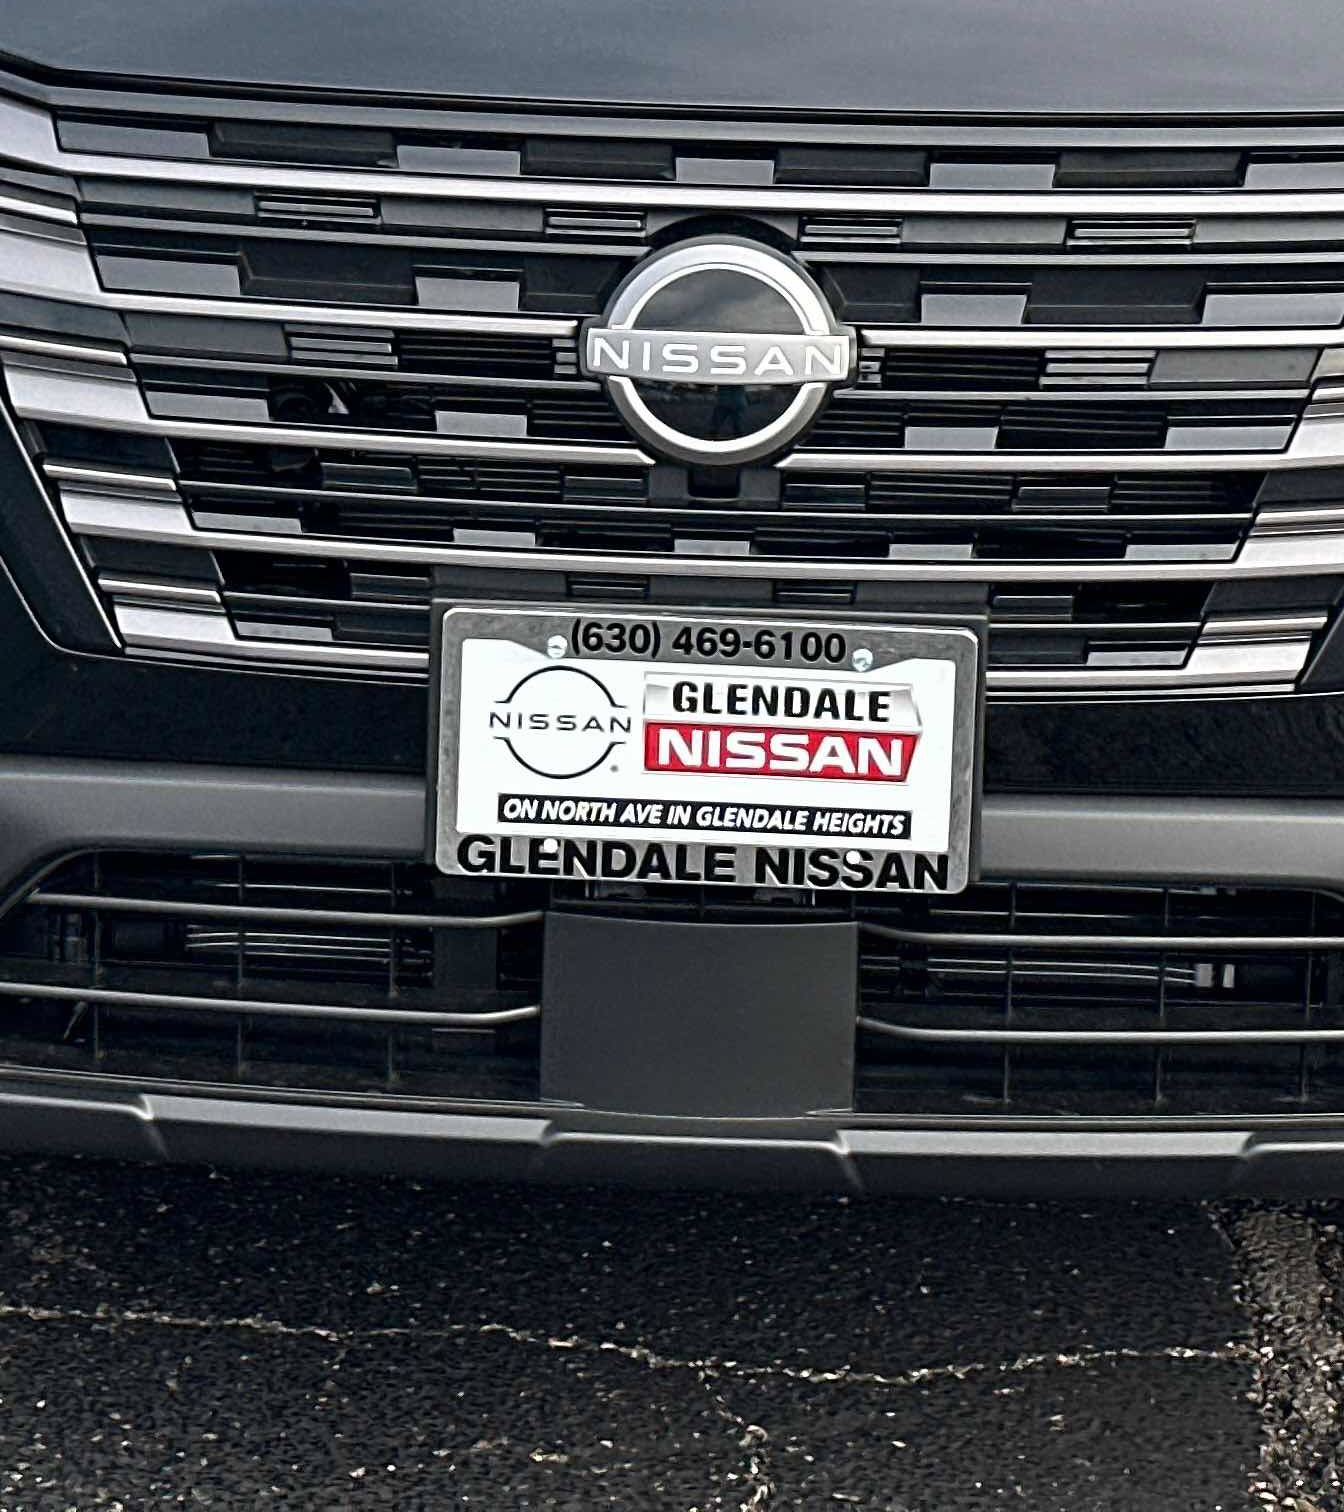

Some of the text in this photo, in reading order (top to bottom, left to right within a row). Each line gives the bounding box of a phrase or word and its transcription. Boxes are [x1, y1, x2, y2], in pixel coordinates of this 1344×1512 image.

[593, 337, 843, 377] NISSAN
[571, 618, 846, 663] (630) 469-6100
[489, 711, 632, 733] NISSAN
[672, 681, 891, 722] GLENDALE
[657, 728, 903, 776] NISSAN
[503, 798, 906, 835] ON NORTH AVE IN GLENDALE HEIGHTS
[456, 833, 949, 891] GLENDALE NISSAN
